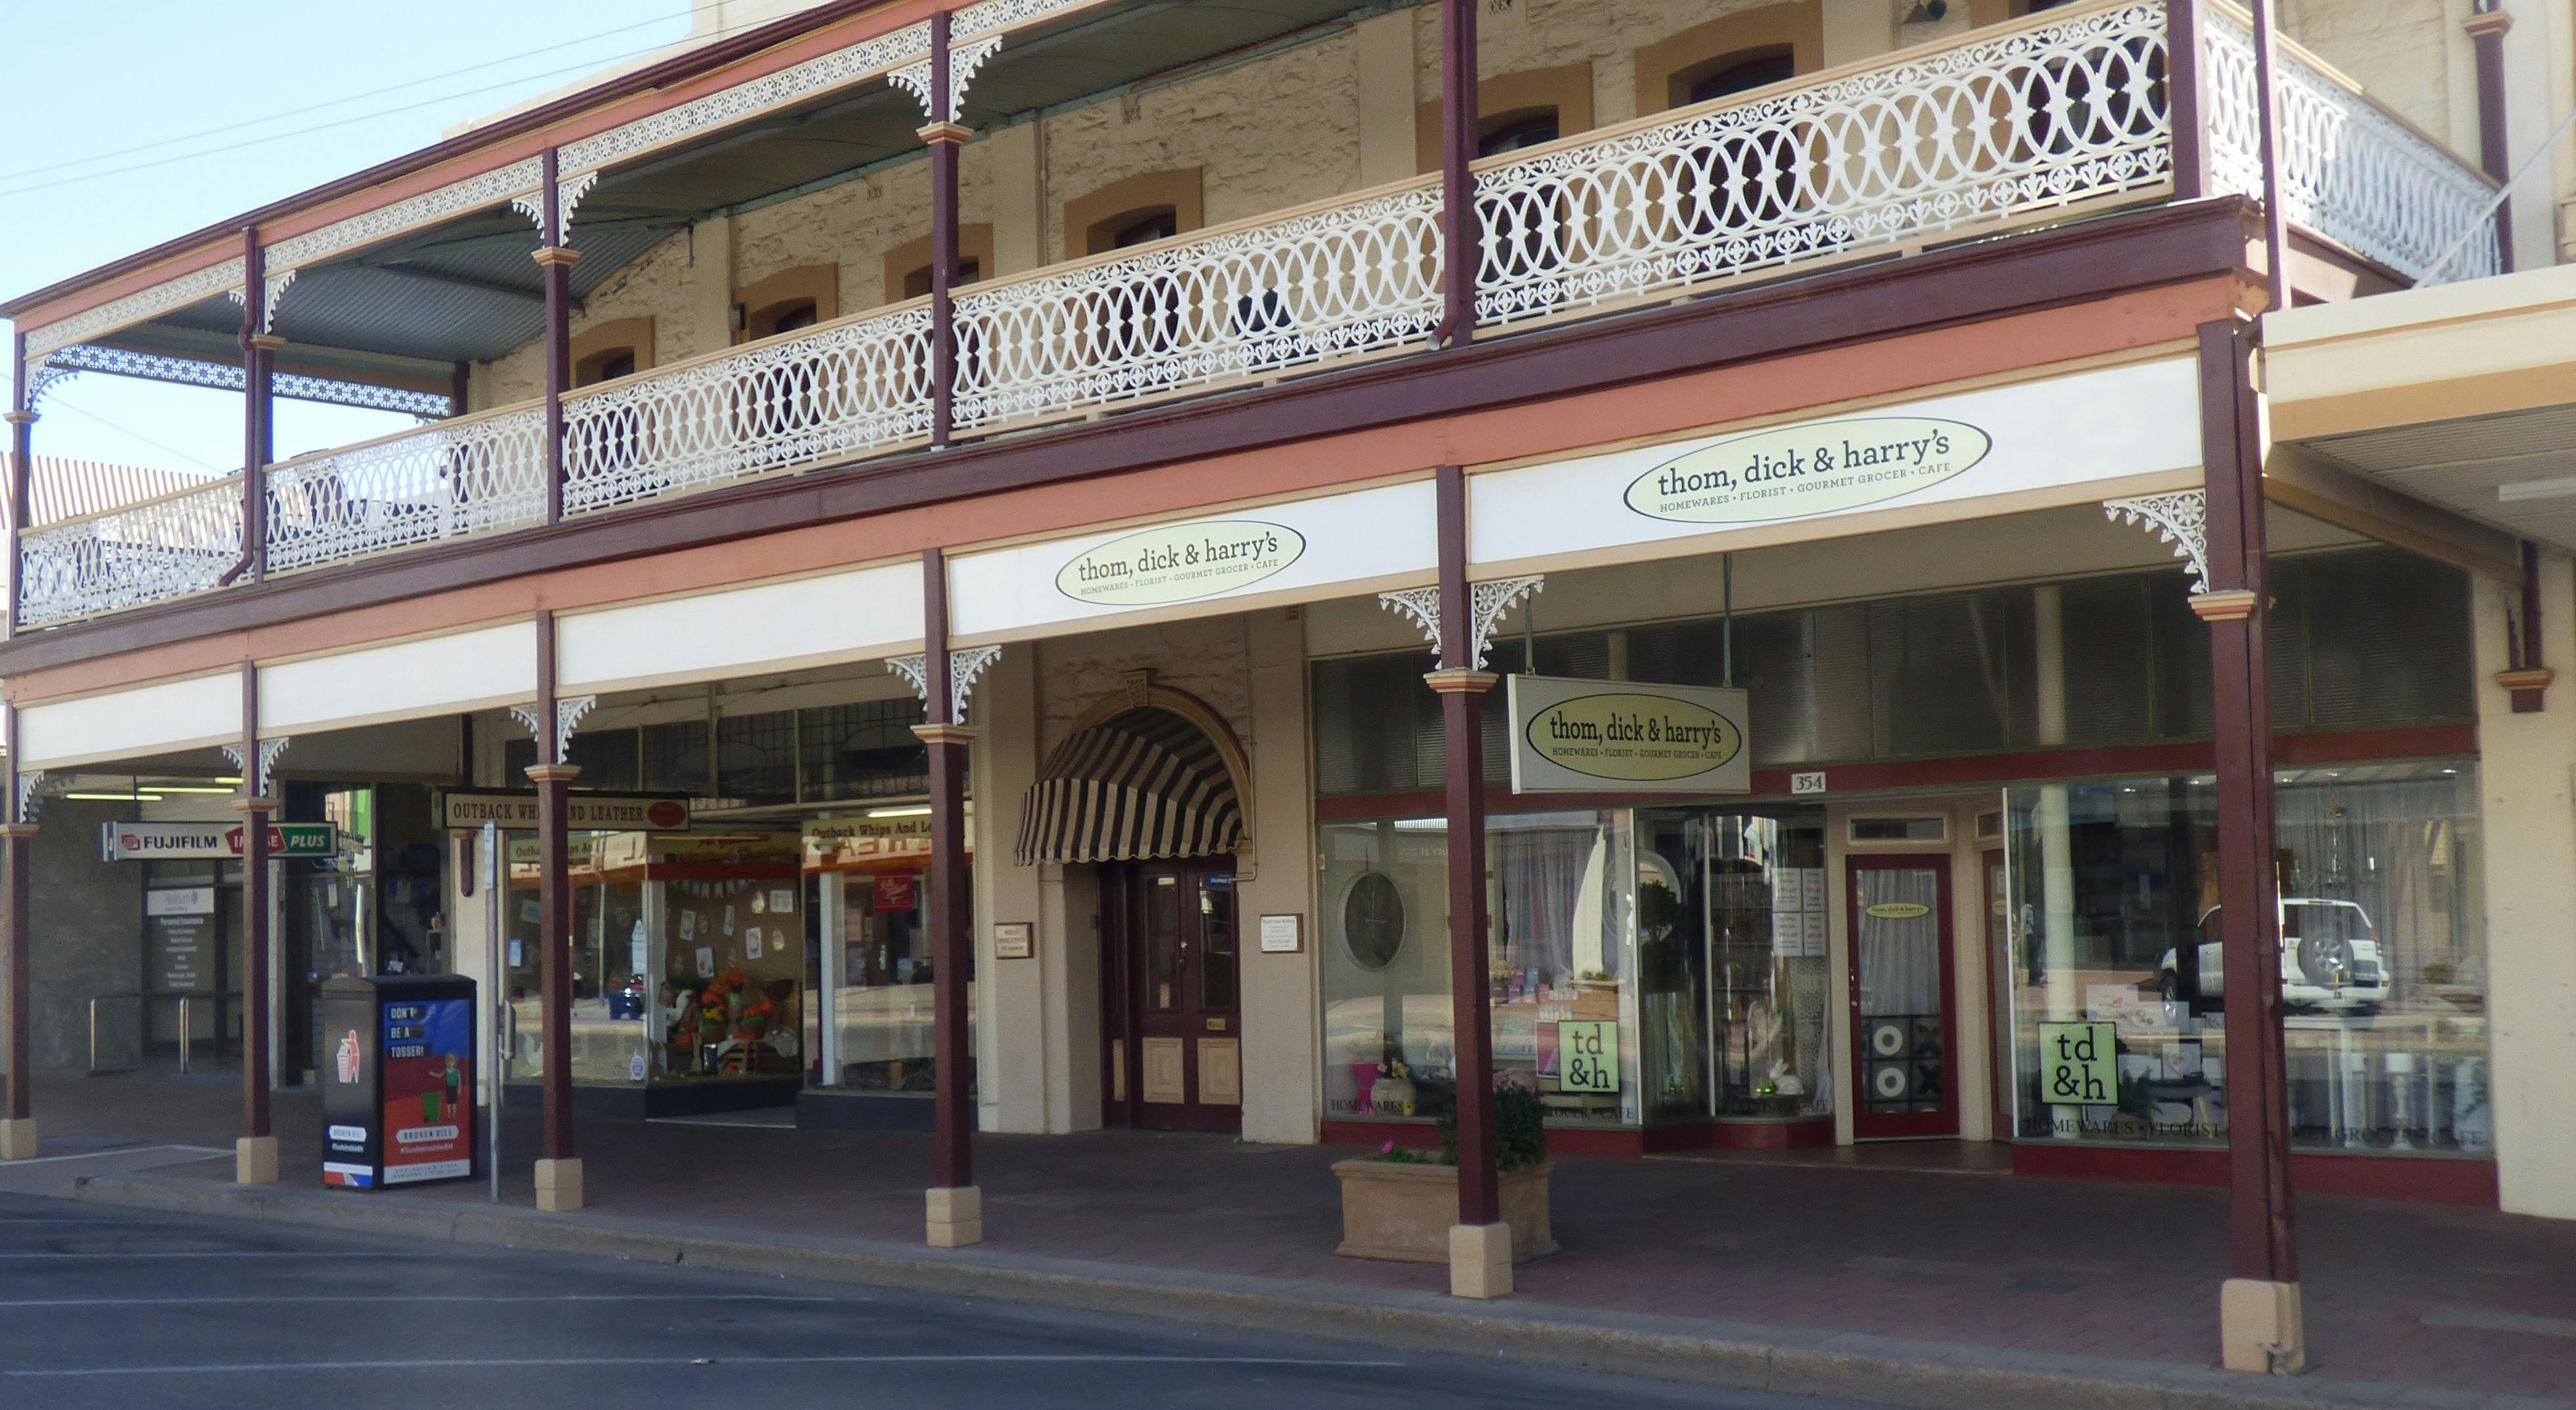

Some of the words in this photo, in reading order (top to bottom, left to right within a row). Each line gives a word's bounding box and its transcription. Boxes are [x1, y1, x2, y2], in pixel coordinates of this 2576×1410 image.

[1657, 468, 1738, 497] thom,
[1744, 448, 1806, 484] dick
[1813, 446, 1836, 472] &
[1842, 428, 1951, 469] harry's
[1659, 495, 1731, 513] HOMEWARES
[1739, 486, 1787, 502] FLORIST
[1797, 476, 1855, 493] GOURMET
[1858, 468, 1908, 485] GROCER
[1918, 462, 1951, 476] CAFE
[1078, 557, 1134, 583] thom,
[1137, 544, 1180, 573] dick
[1184, 543, 1200, 564] &
[1204, 531, 1278, 563] harry's
[1080, 581, 1130, 596] HOMEWARES
[1135, 575, 1168, 587] FLORIST
[1173, 569, 1214, 581] GOURMET
[1215, 564, 1249, 576] GROCER
[1256, 559, 1279, 570] CAFE
[1550, 711, 1603, 745] thom,
[1607, 713, 1644, 741] dick
[1648, 718, 1661, 742] &
[1664, 715, 1722, 750] harry's
[1552, 747, 1599, 757] HOMEWARES
[1796, 775, 1823, 791] 354
[453, 802, 512, 820] OUTBACK
[569, 806, 584, 821] ND
[591, 805, 644, 822] LEATHER
[143, 836, 218, 849] FUJIFILM
[290, 835, 326, 848] PLUS
[811, 827, 855, 839] Outback
[859, 824, 891, 838] Whips
[895, 822, 916, 834] And
[391, 1027, 401, 1039] BE
[403, 1027, 410, 1038] A
[1572, 1023, 1604, 1056] td
[2057, 1026, 2098, 1062] td
[391, 1045, 424, 1058] TOSSER!
[1569, 1057, 1609, 1090] &h
[2053, 1065, 2107, 1101] &h
[2026, 1117, 2134, 1136] HOMEWARES
[2149, 1121, 2221, 1138] FLORIST
